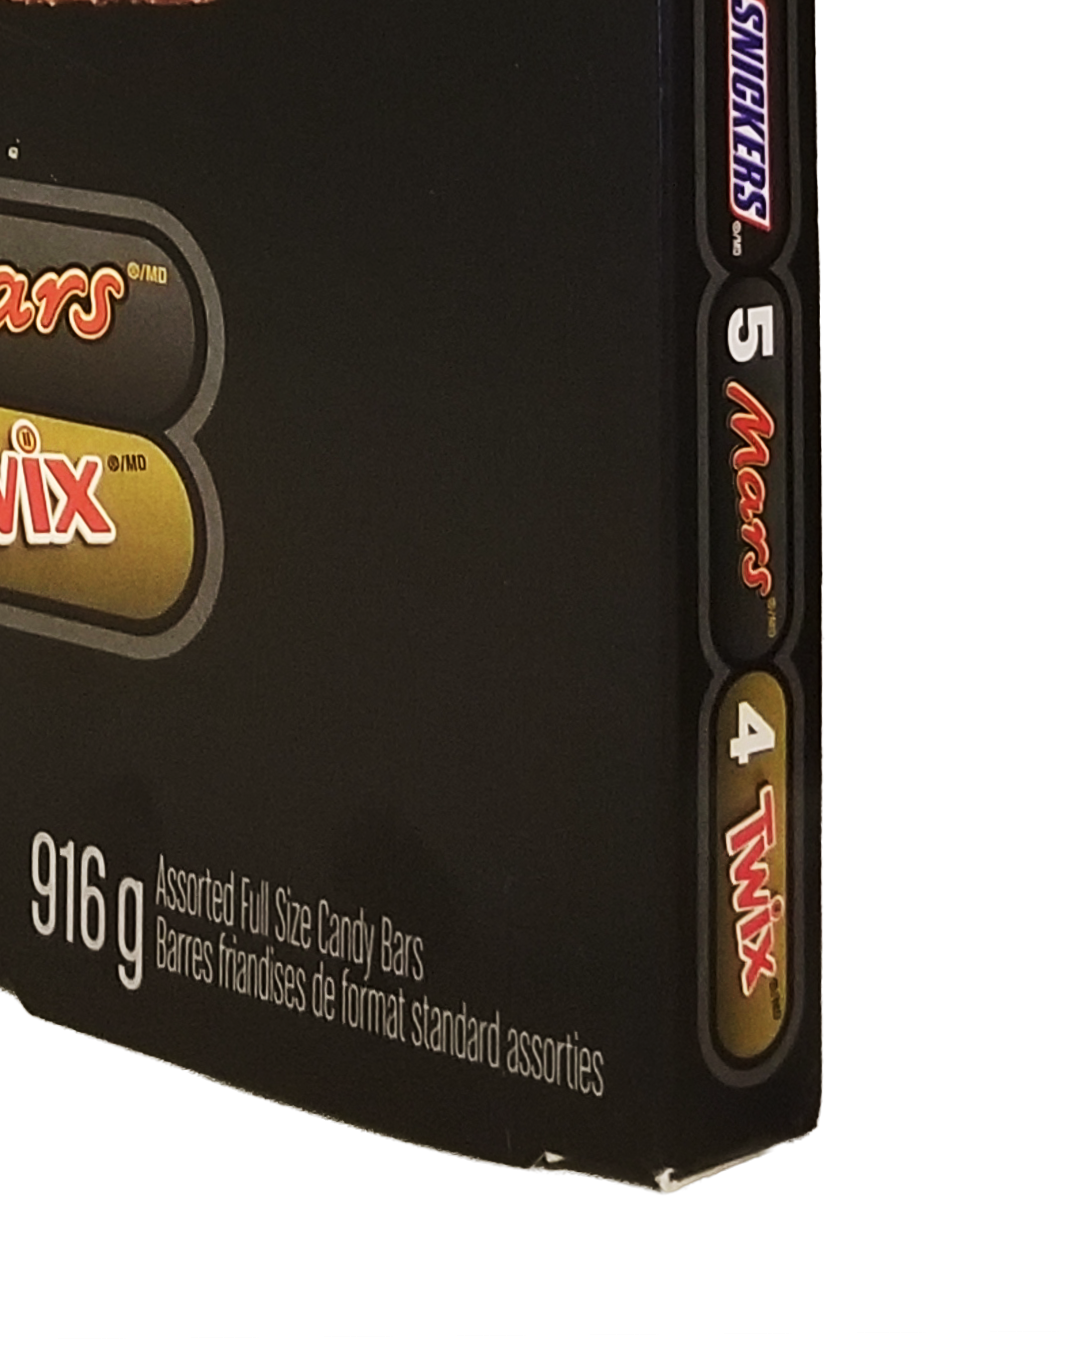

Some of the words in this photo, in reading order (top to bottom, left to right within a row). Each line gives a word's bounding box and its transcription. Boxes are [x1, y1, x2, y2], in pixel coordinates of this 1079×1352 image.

[727, 305, 774, 364] 5
[726, 380, 775, 597] Mars
[730, 701, 775, 764] 4
[31, 831, 107, 952] 916
[117, 876, 145, 990] g
[156, 853, 235, 927] Assorted
[240, 876, 270, 938] Full
[275, 885, 312, 950] Size
[318, 898, 375, 981] Candy
[381, 915, 424, 982] Bars
[156, 915, 213, 984] Barres
[219, 931, 306, 1012] friandises
[312, 961, 336, 1023] de
[341, 967, 406, 1043] format
[411, 997, 500, 1070] standard
[507, 1025, 605, 1097] assorties
